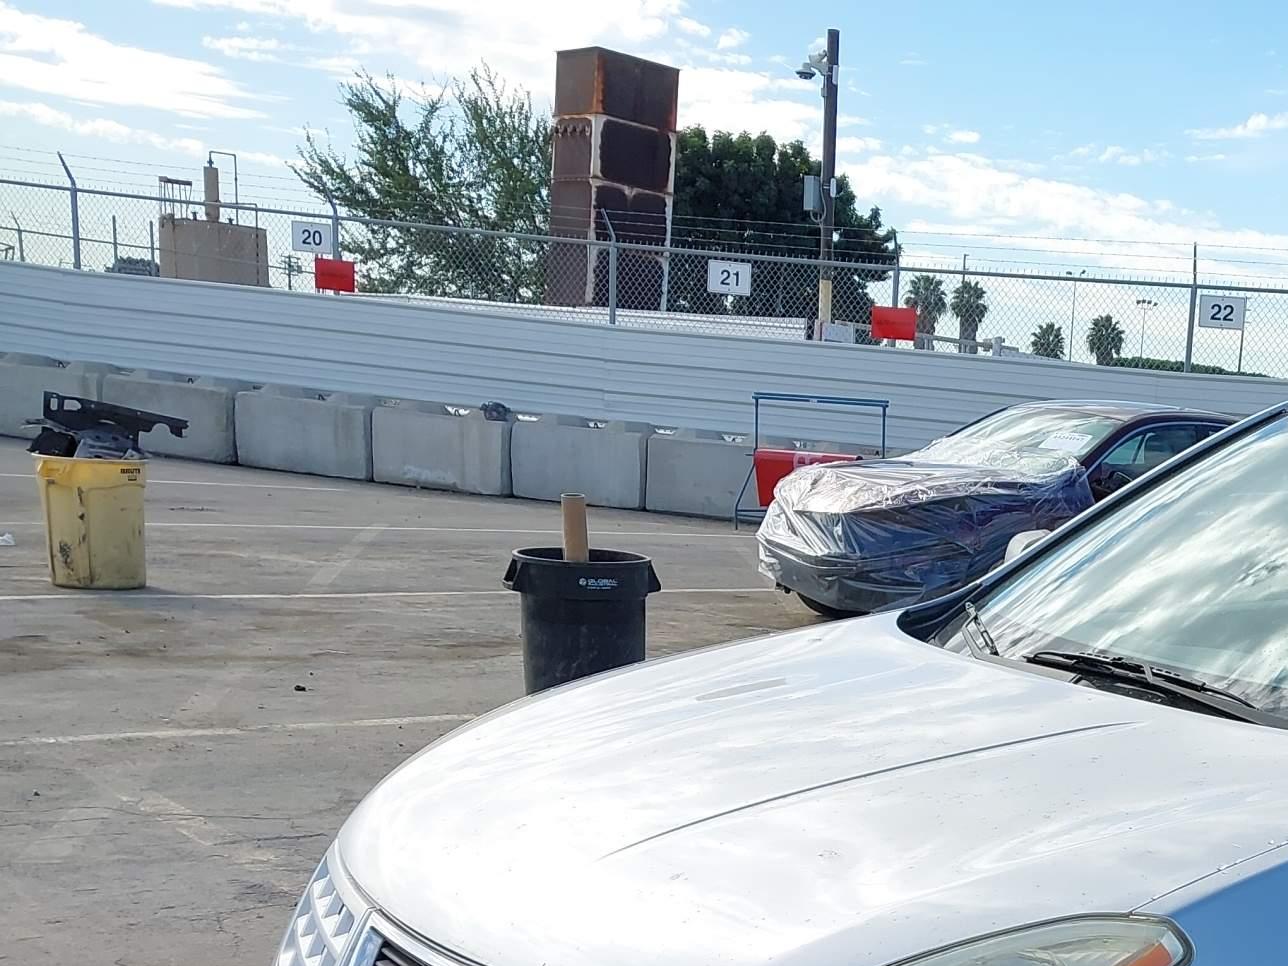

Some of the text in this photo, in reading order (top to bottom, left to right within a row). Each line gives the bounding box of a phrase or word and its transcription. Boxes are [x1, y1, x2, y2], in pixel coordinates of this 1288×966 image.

[302, 229, 322, 246] 20
[720, 269, 740, 287] 21
[1210, 303, 1234, 322] 22
